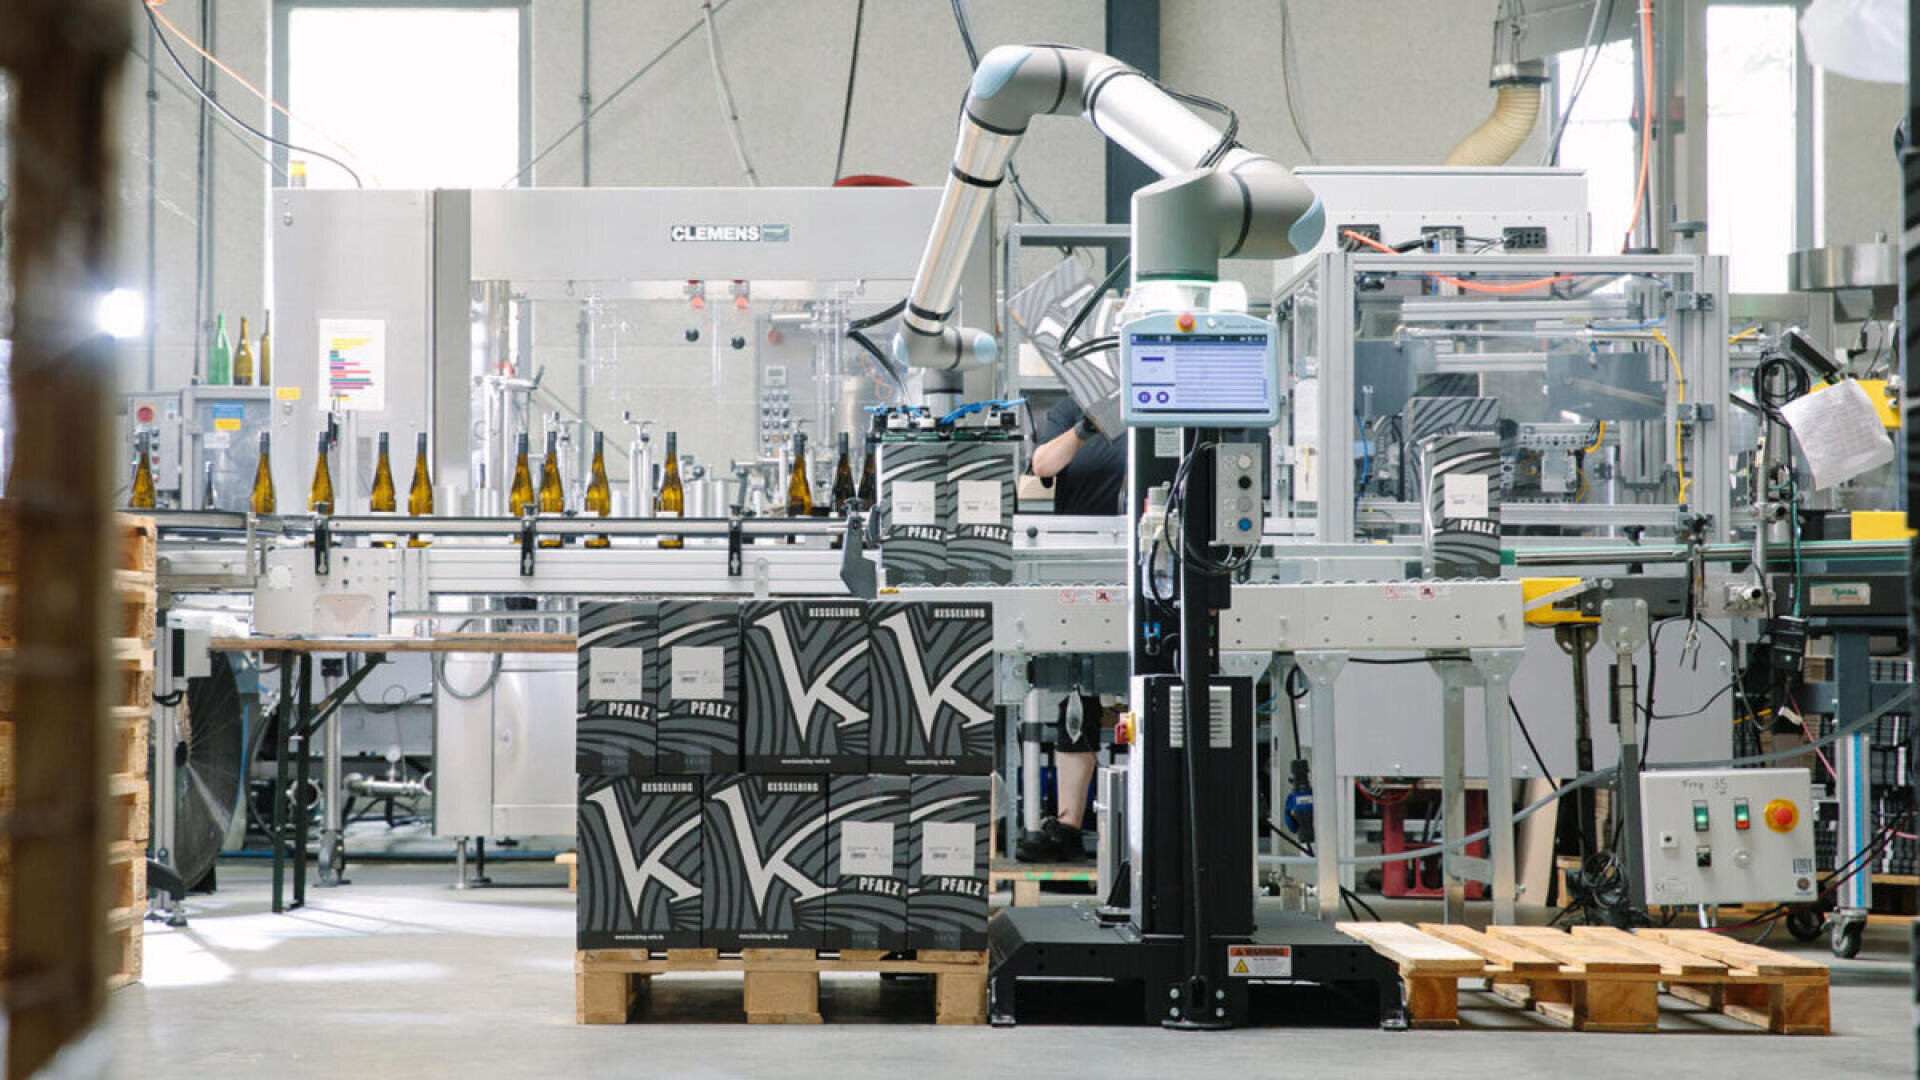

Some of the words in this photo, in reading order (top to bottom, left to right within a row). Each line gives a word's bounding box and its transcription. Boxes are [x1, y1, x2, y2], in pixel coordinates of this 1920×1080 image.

[672, 226, 760, 241] CLEMENS
[908, 526, 942, 540] PFALZ
[973, 526, 1008, 540] PFALZ
[1461, 519, 1495, 534] PFALZ
[809, 607, 861, 618] KESSELRING
[934, 608, 986, 619] KESSELRING
[607, 702, 649, 720] PFALZ
[690, 701, 732, 719] PFALZ
[641, 782, 693, 793] KESSELRING
[767, 782, 819, 793] KESSELRING
[858, 877, 901, 895] PFALZ
[940, 877, 982, 896] PFALZ
